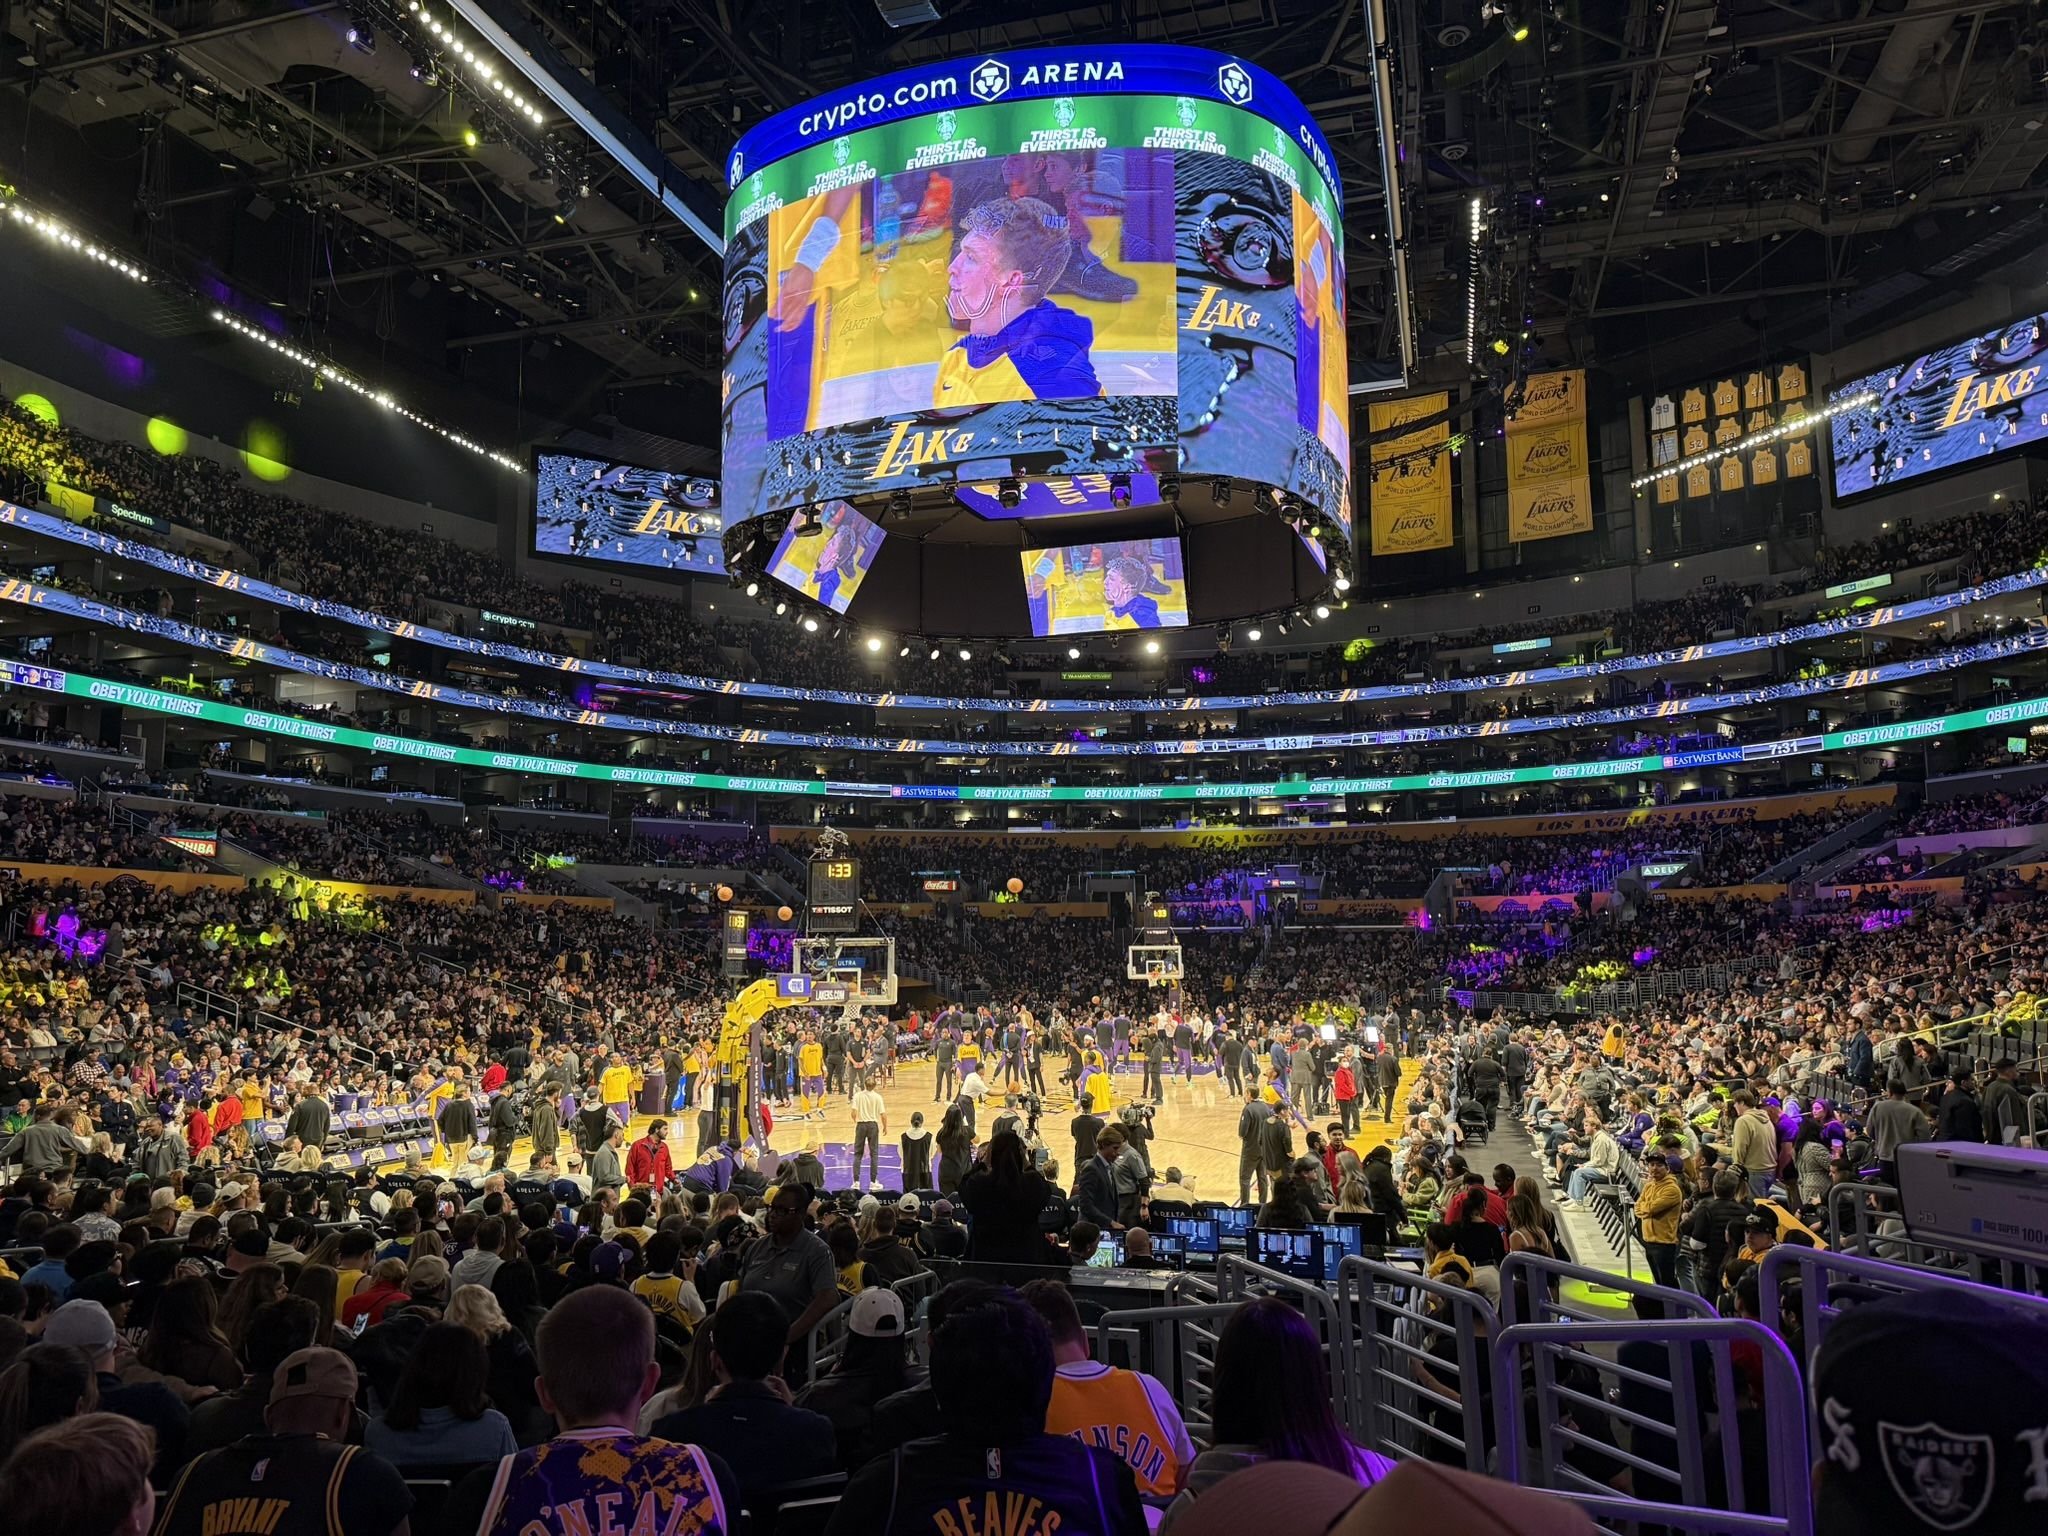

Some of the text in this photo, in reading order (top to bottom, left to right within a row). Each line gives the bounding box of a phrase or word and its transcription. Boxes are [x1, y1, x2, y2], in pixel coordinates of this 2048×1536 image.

[799, 62, 1125, 137] crypto.com ARENA
[1030, 127, 1097, 142] THIRST IS
[1153, 126, 1216, 143] THIRST IS
[915, 137, 977, 158] THIRST IS
[1020, 136, 1107, 153] EVERYTHING
[1143, 136, 1227, 155] EVERYTHING
[906, 147, 987, 170] EVERYTHING
[815, 160, 867, 186] THIRST IS
[807, 167, 876, 198] EVERYTHING
[739, 191, 777, 221] THIRST IS
[735, 198, 783, 234] EVERYTHING
[1784, 377, 1800, 388] 25
[1719, 395, 1733, 405] 13
[1935, 366, 2041, 431] LAKE
[1655, 404, 1669, 414] 99
[1687, 402, 1701, 412] 22
[1525, 444, 1570, 463] LAKERS
[1793, 455, 1805, 466] 16
[1728, 469, 1735, 479] 8
[1757, 462, 1771, 473] 24
[111, 503, 153, 526] Spectrum
[1526, 499, 1575, 519] LAKERS
[1391, 517, 1436, 534] LAKERS
[1522, 522, 1543, 531] WORLD
[1544, 513, 1579, 532] CHAMPIONS
[1843, 583, 1856, 592] UCLA
[1506, 639, 1536, 648] AMERICAN
[90, 681, 161, 706] OBEY YOUR
[1986, 699, 2048, 723] OBEY YOUR
[244, 712, 272, 728] OBEY
[272, 716, 301, 735] YOUR
[1271, 738, 1297, 749] 1:33
[1362, 735, 1368, 744] 0
[1843, 733, 1872, 745] OBEY
[1873, 728, 1905, 740] YOUR
[373, 736, 398, 752] OBEY
[399, 740, 424, 755] YOUR
[1212, 742, 1218, 751] 0
[1769, 740, 1799, 754] 7:31
[492, 755, 517, 768] OBEY
[518, 757, 548, 771] YOUR
[1717, 750, 1742, 761] BANK
[611, 768, 637, 780] OBEY
[638, 771, 664, 783] YOUR
[1552, 766, 1577, 778] OBEY
[1577, 763, 1608, 776] YOUR
[728, 778, 752, 790] OBEY
[752, 779, 778, 791] YOUR
[1309, 781, 1334, 793] OBEY
[1334, 780, 1359, 791] YOUR
[1429, 776, 1454, 788] OBEY
[1455, 773, 1481, 786] YOUR
[974, 788, 999, 798] OBEY
[999, 788, 1022, 799] YOUR
[1084, 788, 1109, 798] OBEY
[1109, 788, 1131, 798] YOUR
[1195, 786, 1219, 796] OBEY
[1219, 785, 1243, 796] YOUR
[1535, 820, 1574, 832] LOS
[1672, 806, 1758, 823] LAKERS
[1190, 833, 1224, 845] LOS
[1232, 831, 1308, 845] ANGELES
[828, 863, 851, 878] 1:33
[823, 906, 852, 914] TISSOT
[1304, 904, 1316, 912] 107
[1160, 1209, 1185, 1218] DELTA
[1999, 1223, 2020, 1235] SUPER
[1891, 1432, 1980, 1456] RAIDERS
[201, 1496, 292, 1536] BRYANT
